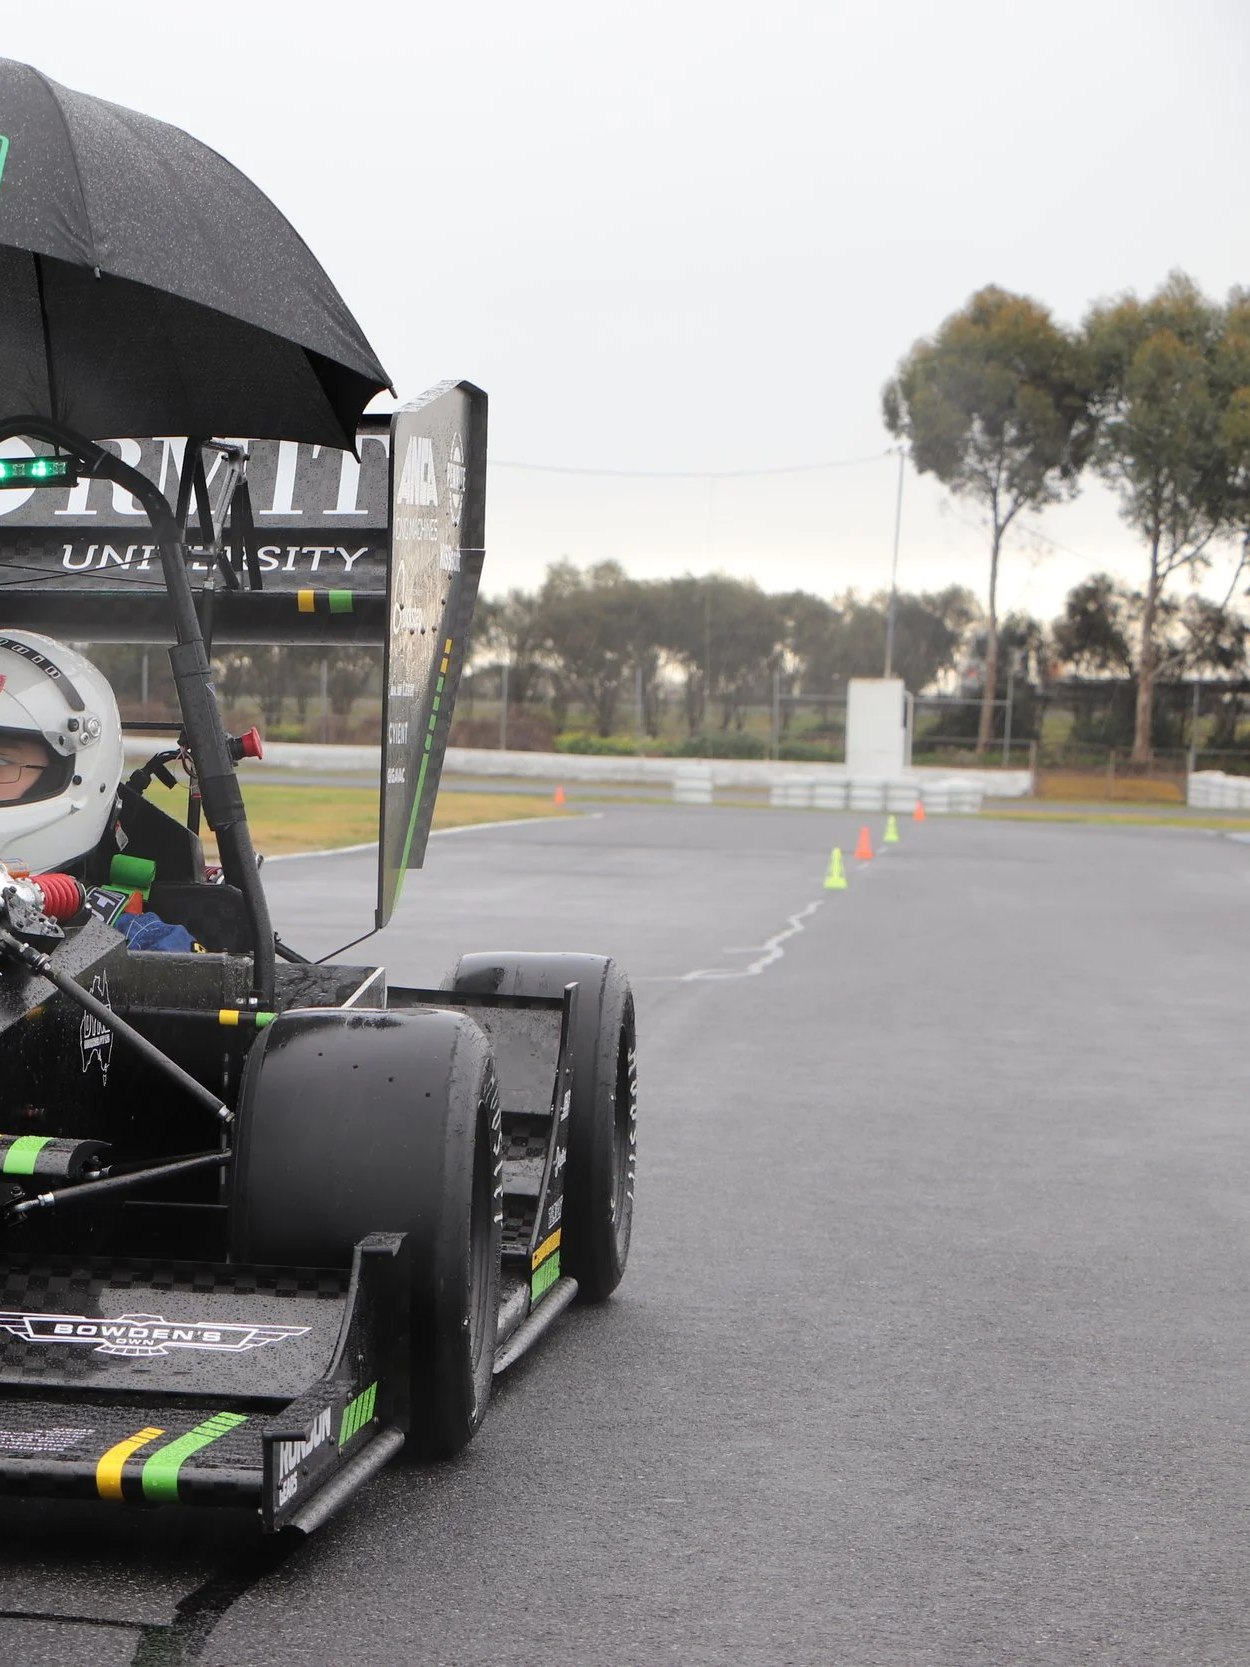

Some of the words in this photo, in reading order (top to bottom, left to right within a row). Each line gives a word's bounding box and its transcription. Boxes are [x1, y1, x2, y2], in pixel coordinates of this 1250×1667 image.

[396, 434, 438, 507] ANCA
[53, 1323, 222, 1342] BOWDEN'S
[115, 1337, 156, 1346] OWN
